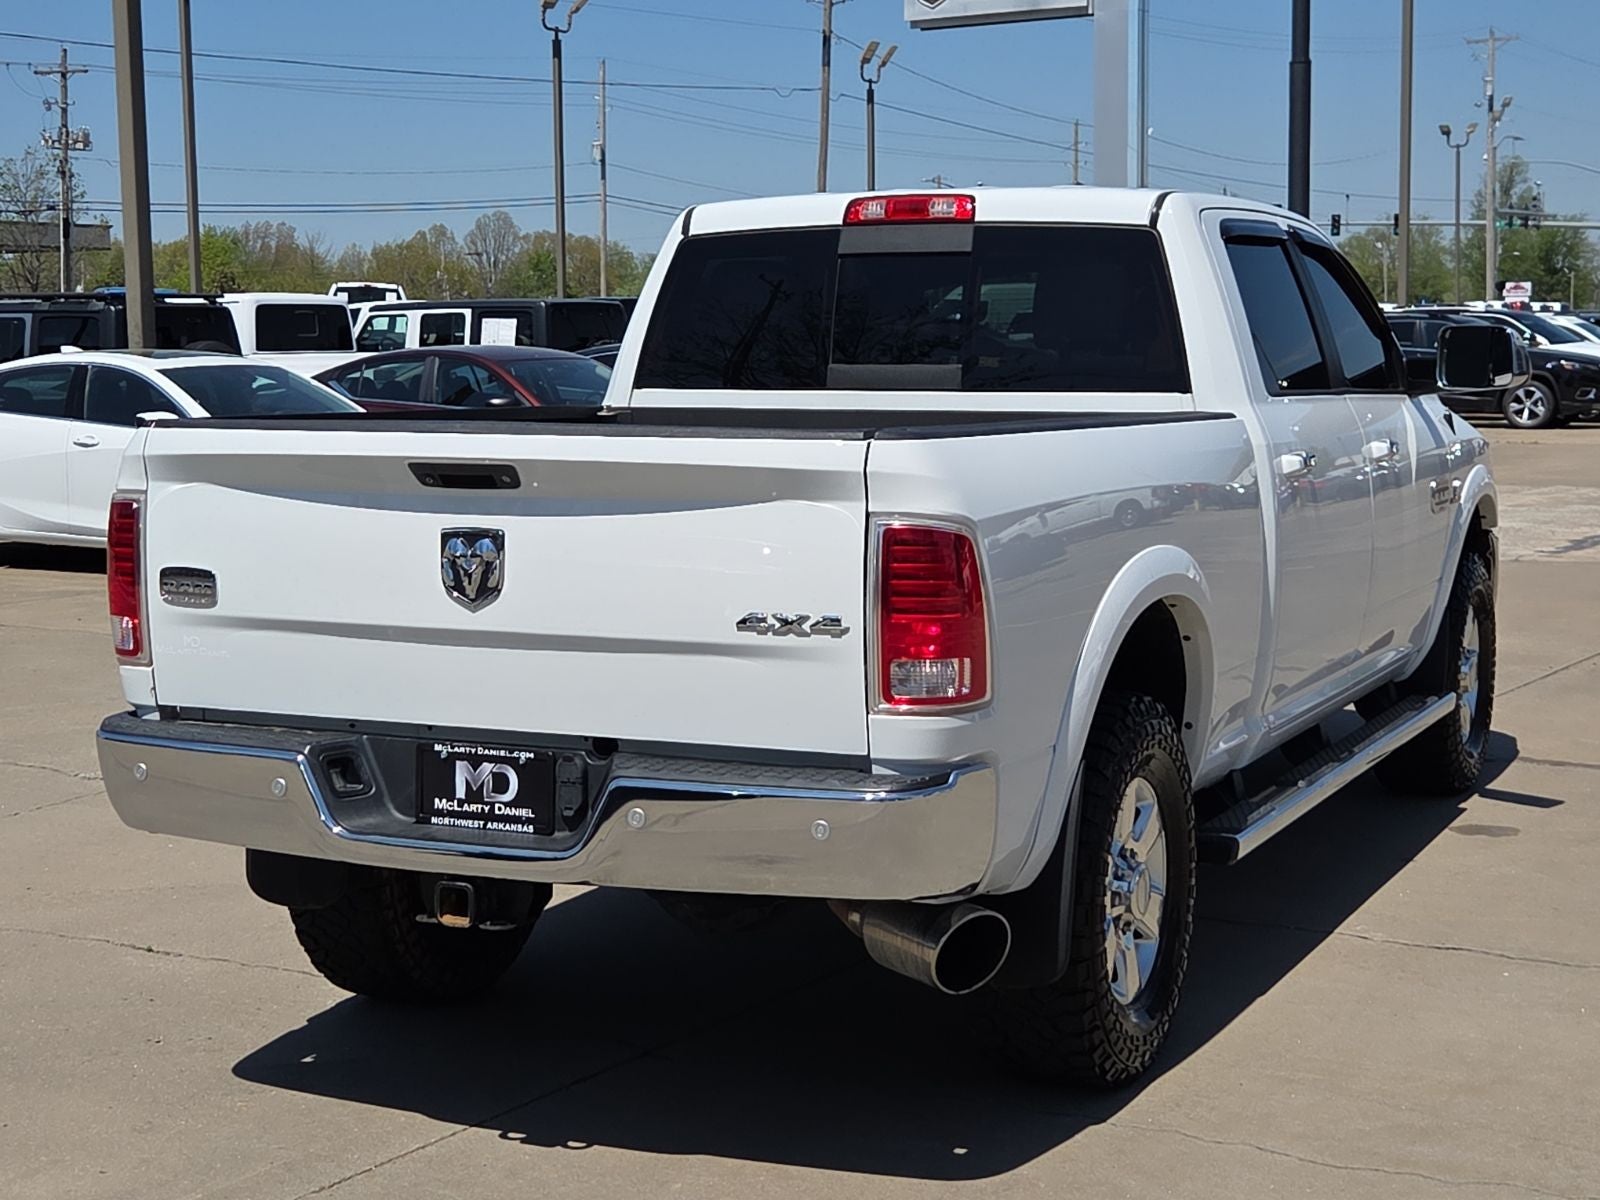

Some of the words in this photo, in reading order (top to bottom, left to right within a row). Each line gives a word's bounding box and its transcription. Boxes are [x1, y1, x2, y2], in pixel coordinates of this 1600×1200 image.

[494, 803, 536, 818] DANIEL
[431, 815, 485, 829] NORTHWEST
[486, 821, 534, 834] ARKANSAS
